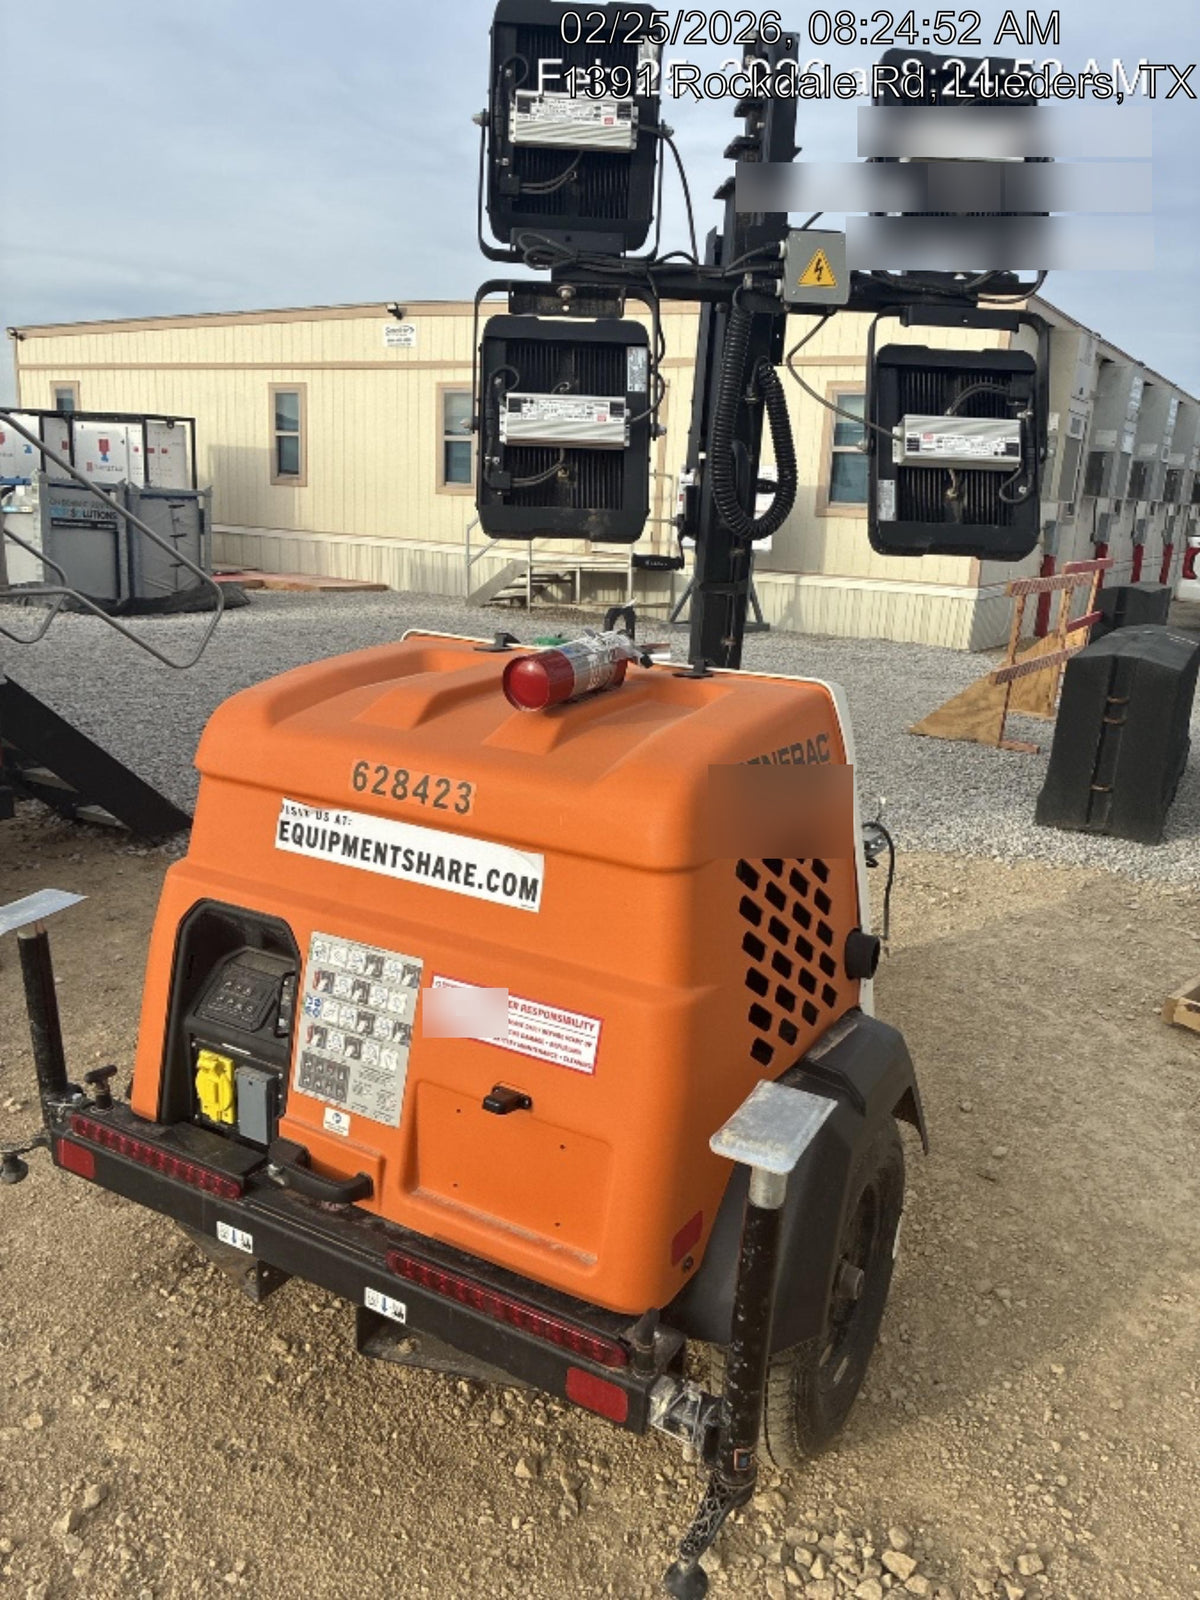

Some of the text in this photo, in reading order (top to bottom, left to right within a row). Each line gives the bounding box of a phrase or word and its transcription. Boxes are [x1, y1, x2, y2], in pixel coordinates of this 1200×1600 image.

[352, 760, 474, 815] 628423
[315, 810, 330, 823] US
[278, 819, 539, 903] EQUIPMENTSHARE.COM
